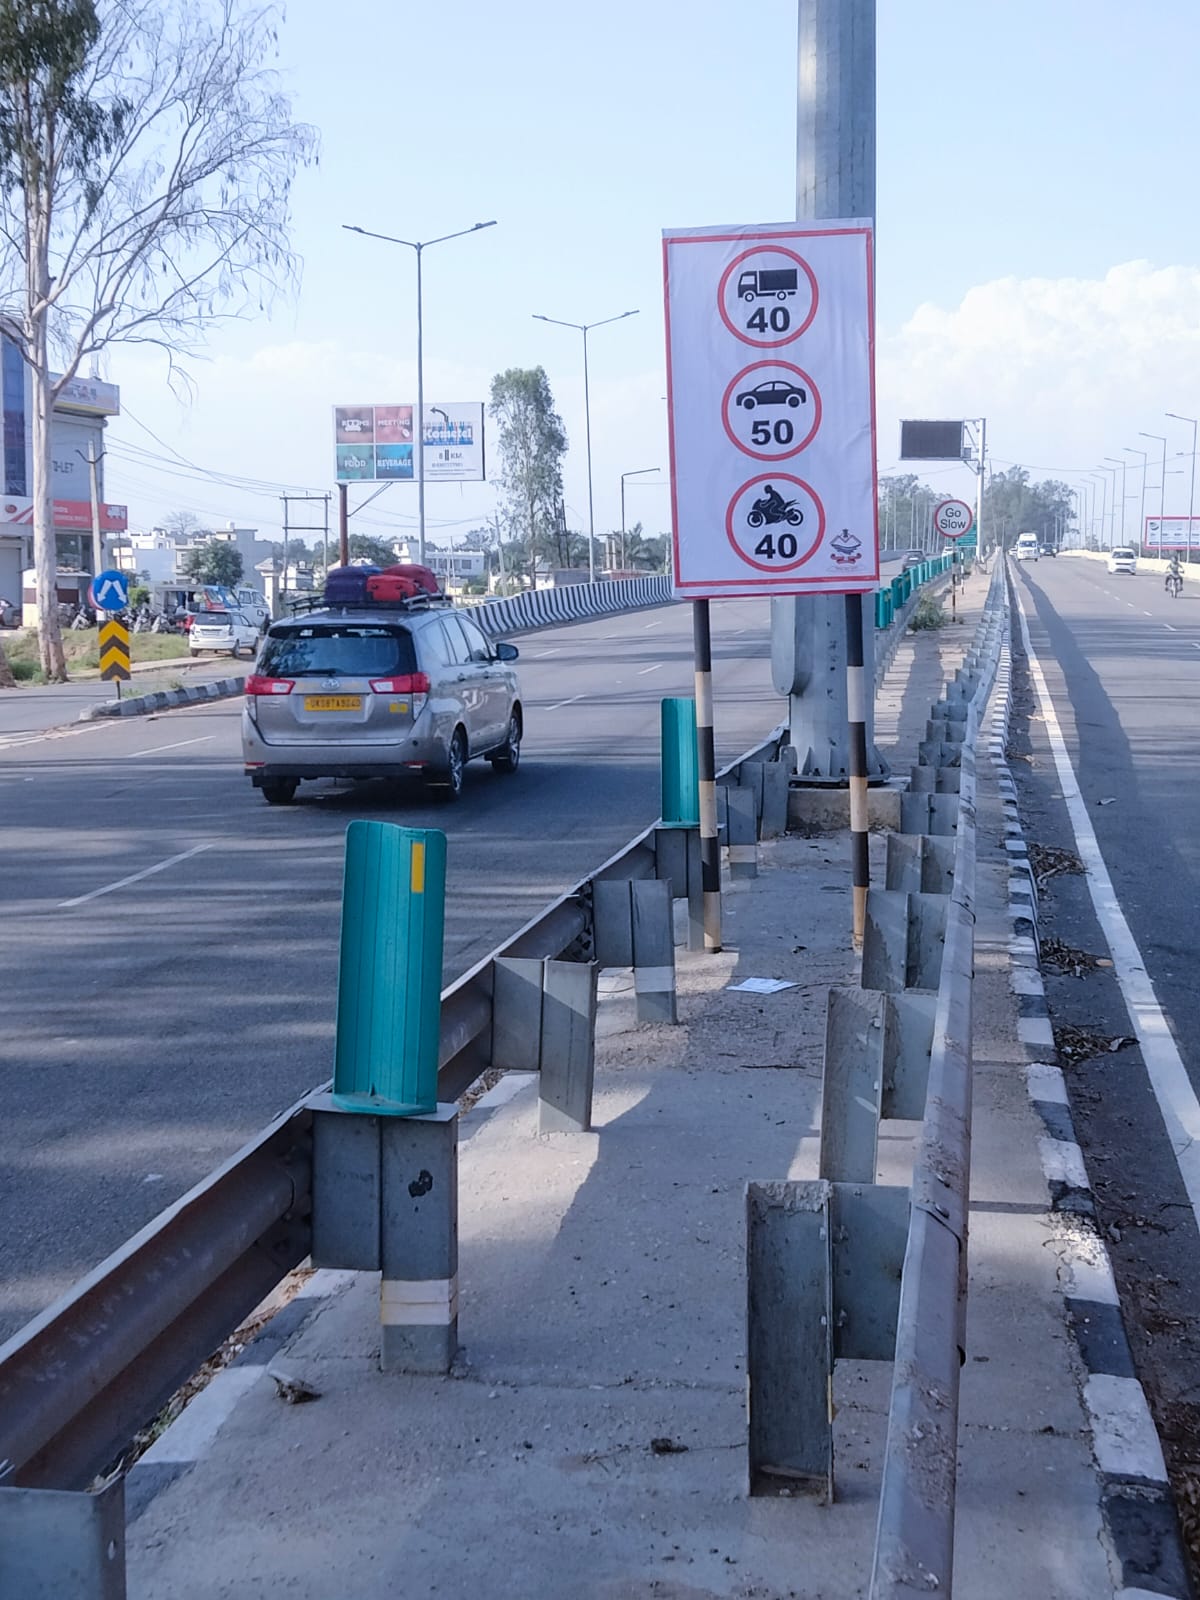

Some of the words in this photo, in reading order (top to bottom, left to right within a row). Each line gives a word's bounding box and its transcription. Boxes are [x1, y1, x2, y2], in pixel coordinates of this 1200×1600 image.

[746, 306, 791, 333] 40
[751, 419, 794, 446] 50
[344, 459, 367, 468] FOOD
[377, 459, 412, 468] BEVERAGE
[945, 507, 962, 518] Go
[940, 519, 967, 529] Slow
[754, 533, 798, 559] 40
